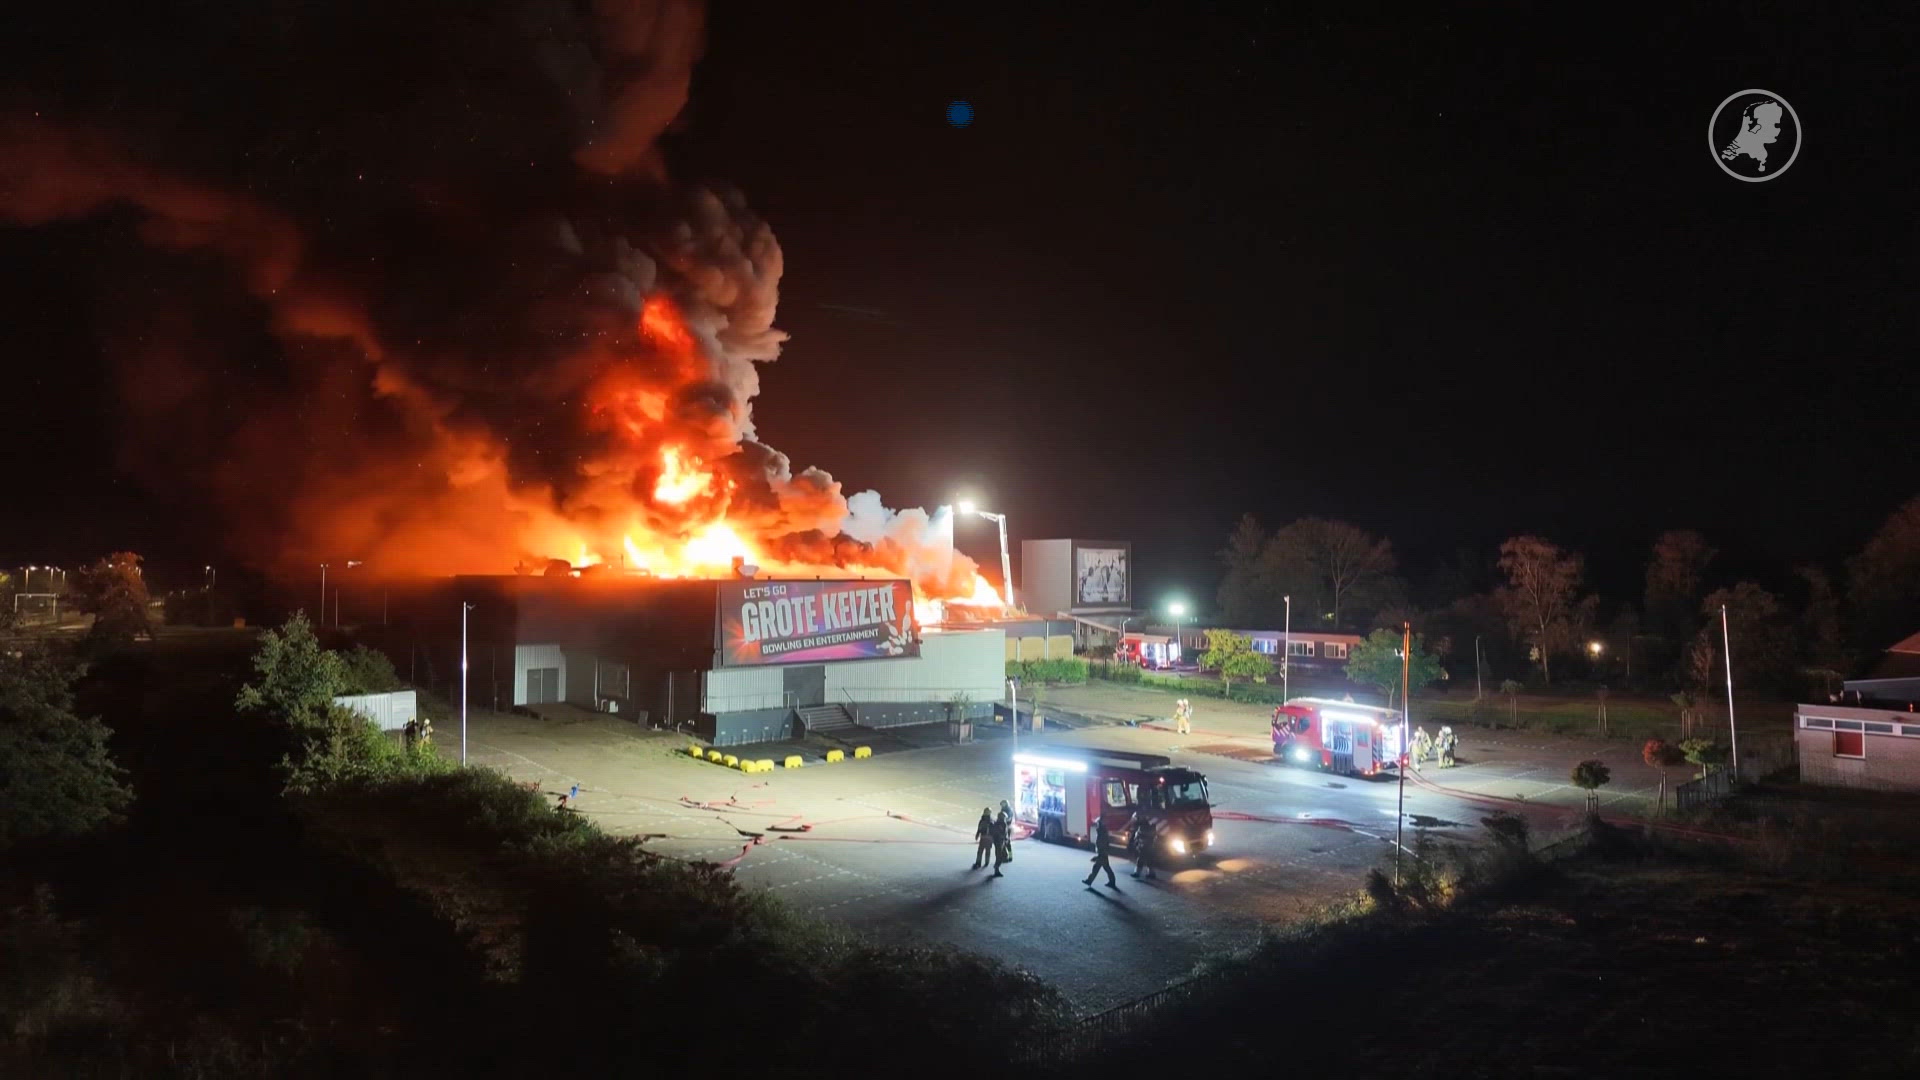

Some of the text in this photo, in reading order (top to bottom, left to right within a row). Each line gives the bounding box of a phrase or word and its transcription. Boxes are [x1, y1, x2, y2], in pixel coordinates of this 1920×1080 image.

[743, 585, 787, 599] LET'S GO
[741, 586, 896, 643] GROTE KEIZER
[762, 628, 879, 655] BOWLING EN ENTERTAINMENT
